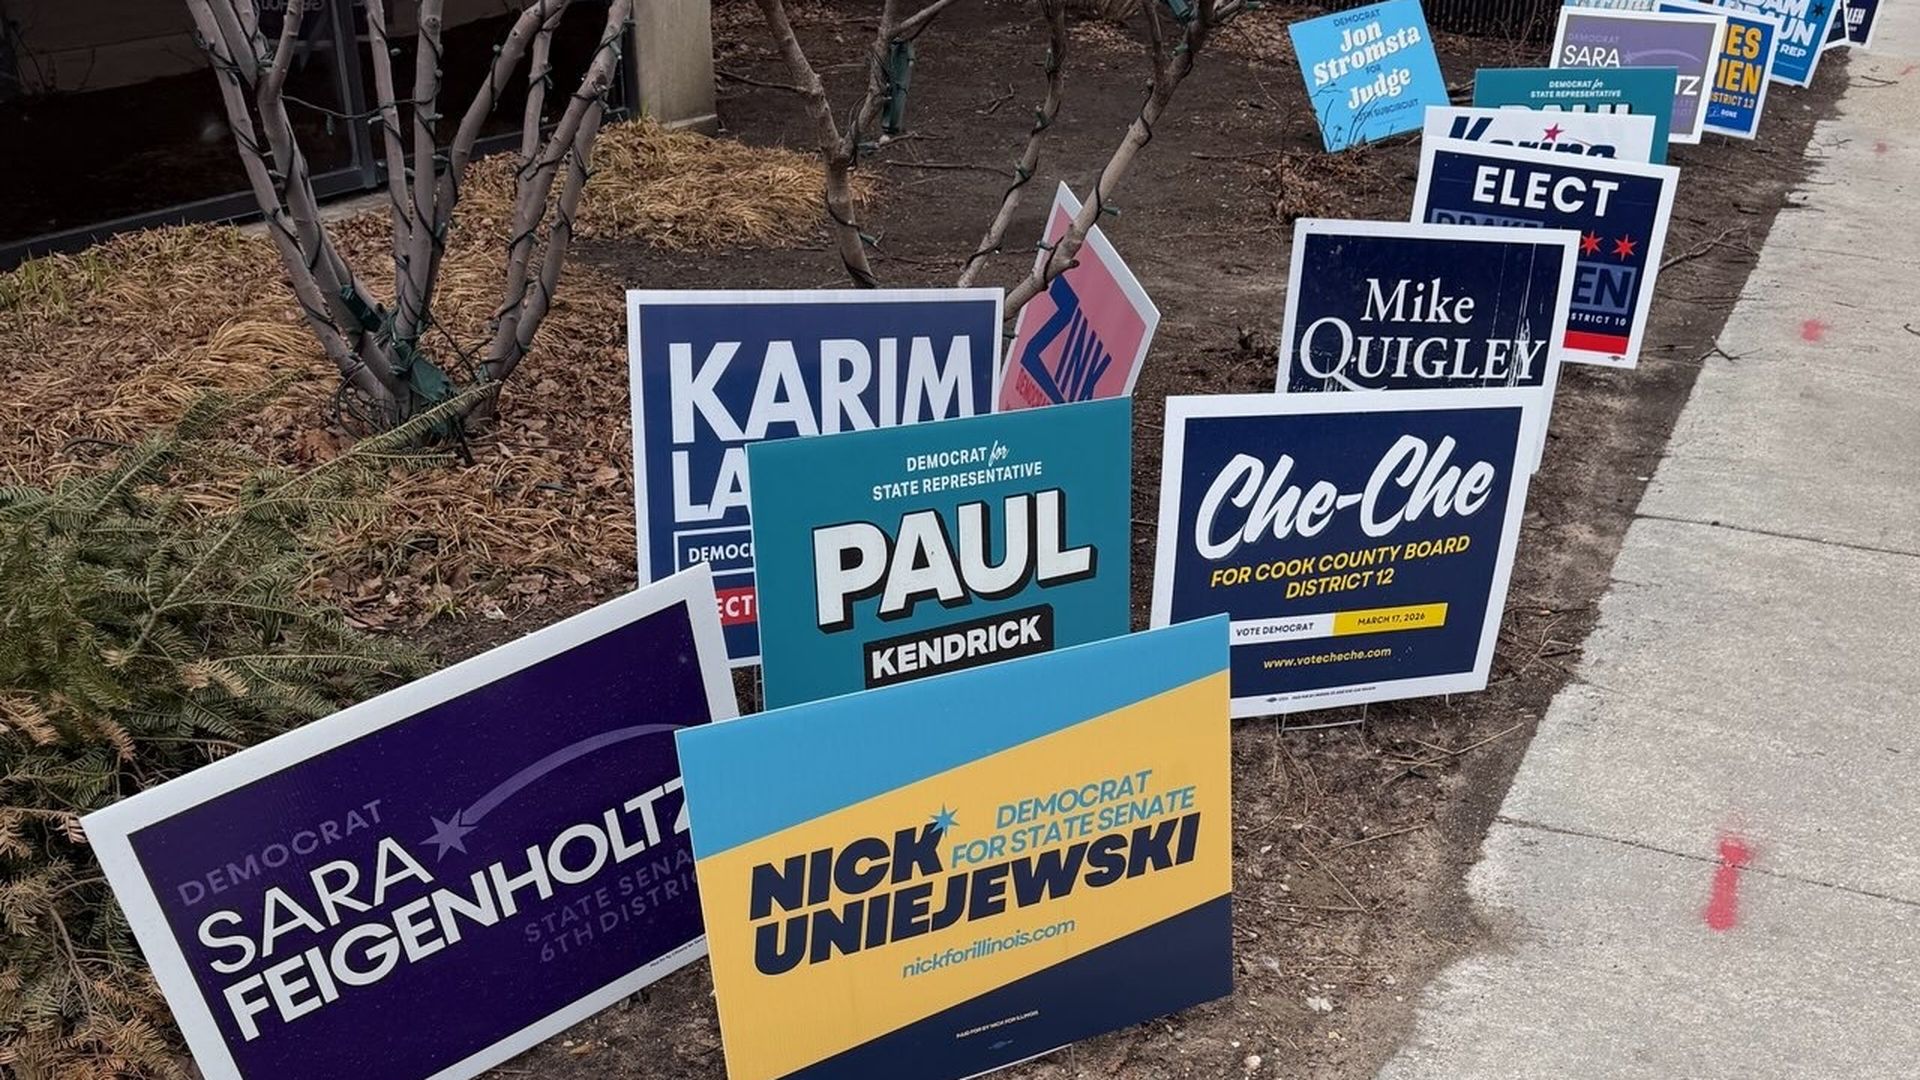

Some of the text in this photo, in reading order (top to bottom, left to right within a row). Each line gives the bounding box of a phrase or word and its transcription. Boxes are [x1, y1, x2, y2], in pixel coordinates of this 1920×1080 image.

[1333, 9, 1381, 27] DEMOCRAT
[1340, 21, 1383, 52] Jon
[1313, 26, 1421, 87] Stromsta
[1365, 64, 1382, 75] FOR
[1563, 45, 1621, 67] SARA
[1780, 44, 1807, 58] REP
[1348, 67, 1412, 109] Judge
[1530, 89, 1622, 99] STATE REPRESENTATIVE
[1549, 80, 1591, 88] DEMOCRAT
[1472, 165, 1619, 217] ELECT
[1360, 277, 1475, 324] Mike
[1615, 317, 1628, 327] 10
[1301, 316, 1546, 391] QUIGLEY
[669, 335, 975, 444] KARIM
[873, 461, 1043, 501] STATE REPRESENTATIVE
[907, 440, 1009, 473] DEMOCRAT for
[1195, 434, 1496, 560] Che-Che
[688, 543, 754, 563] DEMOC
[812, 488, 1098, 634] PAUL
[1211, 535, 1471, 588] FOR COOK COUNTY BOARD
[1285, 567, 1395, 599] DISTRICT 12
[1236, 621, 1314, 638] VOTE DEMOCRAT
[1357, 611, 1426, 627] MARCH 17, 2026
[872, 614, 1042, 680] KENDRICK
[1263, 646, 1392, 670] www.votecheche.com
[996, 769, 1153, 830] DEMOCRAT
[951, 785, 1197, 869] FOR STATE SENATE
[177, 799, 384, 907] DEMOCRAT
[749, 821, 946, 922] NICK
[197, 836, 434, 974] SARA
[525, 887, 612, 942] STATE
[540, 922, 594, 962] 6TH
[600, 870, 697, 933] DISTRI
[753, 812, 1201, 976] UNIEJEWSKI
[902, 917, 1076, 980] nickforillinois.com
